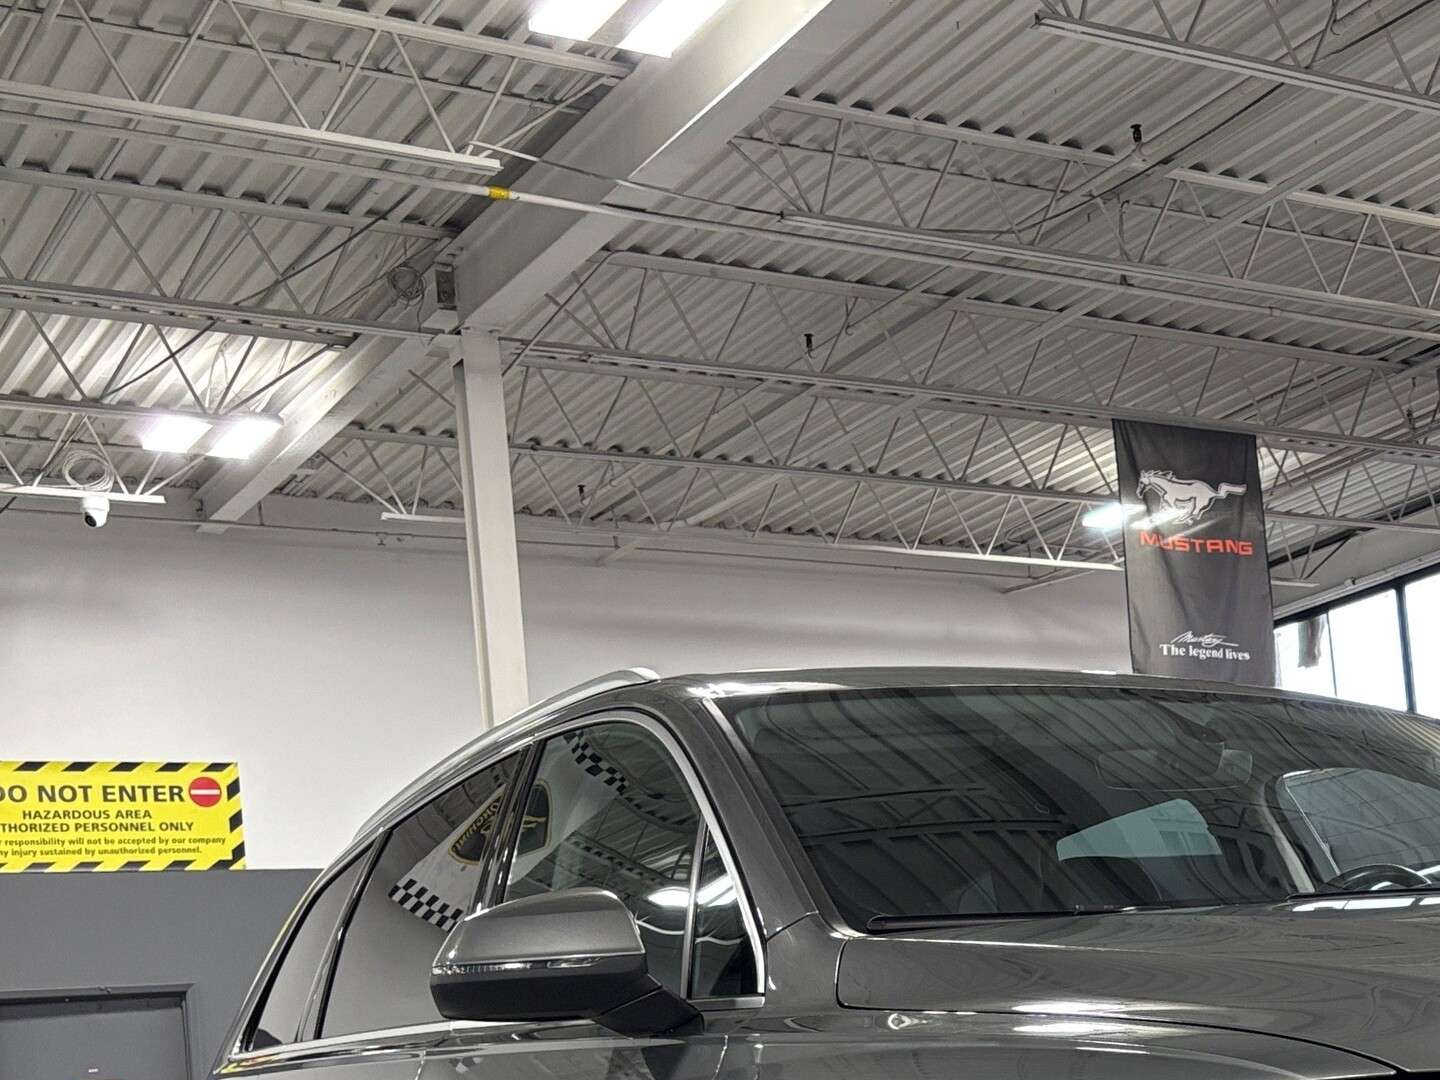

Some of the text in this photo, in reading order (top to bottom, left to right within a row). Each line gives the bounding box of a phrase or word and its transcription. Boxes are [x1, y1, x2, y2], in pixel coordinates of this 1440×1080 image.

[1140, 531, 1253, 556] MUSTANG
[1159, 643, 1250, 660] The legend lives
[37, 784, 92, 803] NOT
[102, 784, 185, 802] ENTER
[22, 809, 152, 820] HAZARDOUS AREA
[0, 821, 194, 833] THORIZED PERSONNEL ONLY
[5, 836, 65, 847] responsibility
[68, 836, 84, 846] will
[86, 837, 102, 845] not
[104, 836, 115, 845] be
[117, 836, 156, 847] accepted
[158, 835, 169, 846] by
[188, 837, 226, 846] company
[11, 849, 37, 858] injury
[40, 848, 82, 856] sustained
[84, 847, 96, 857] by
[98, 846, 155, 855] unauthorized
[157, 846, 202, 855] personnel.
